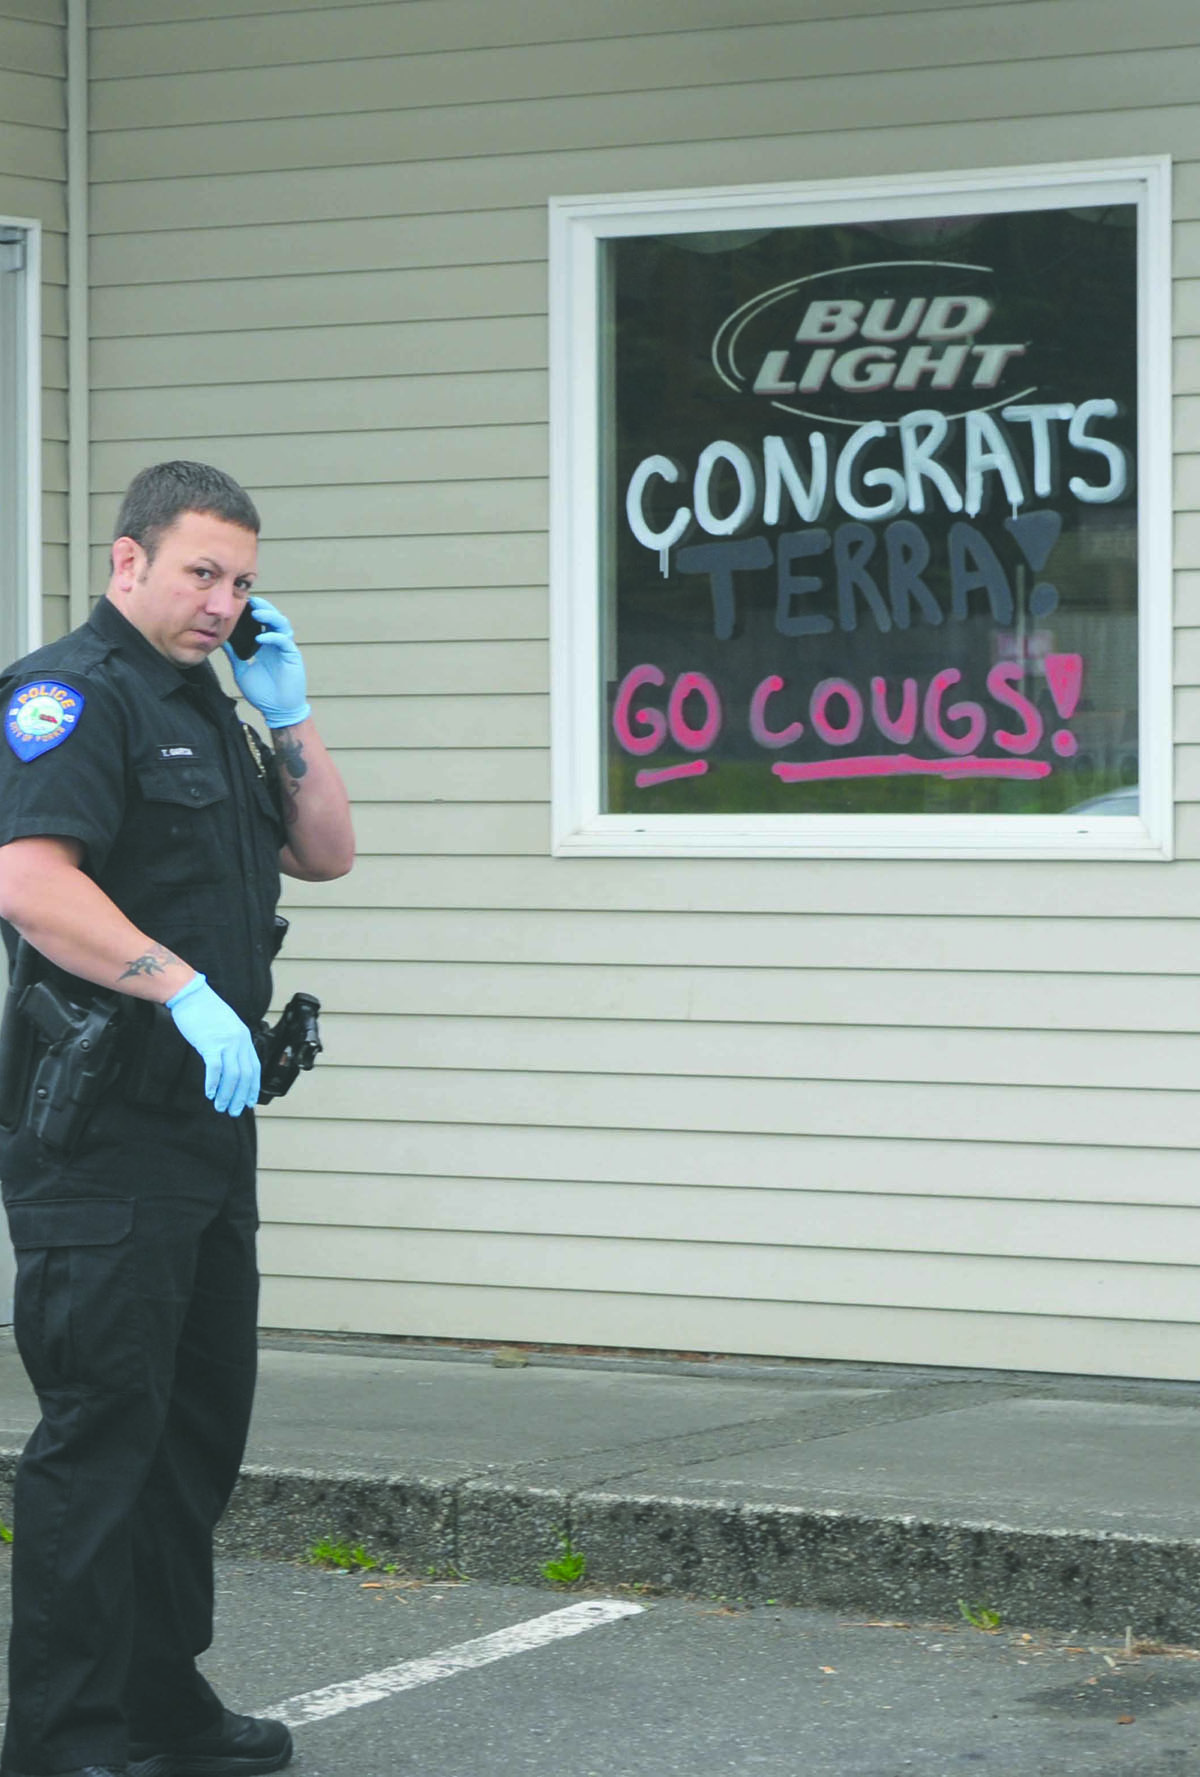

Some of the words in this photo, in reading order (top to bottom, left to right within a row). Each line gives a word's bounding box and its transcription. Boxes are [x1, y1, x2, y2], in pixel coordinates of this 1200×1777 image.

[796, 296, 993, 343] BUD
[753, 344, 1025, 394] LIGHT
[626, 399, 1127, 551] CONGRATS
[676, 510, 1062, 640] TERRA!
[18, 685, 76, 709] POLICE
[613, 664, 722, 756] GO
[750, 653, 1082, 756] COUGS!
